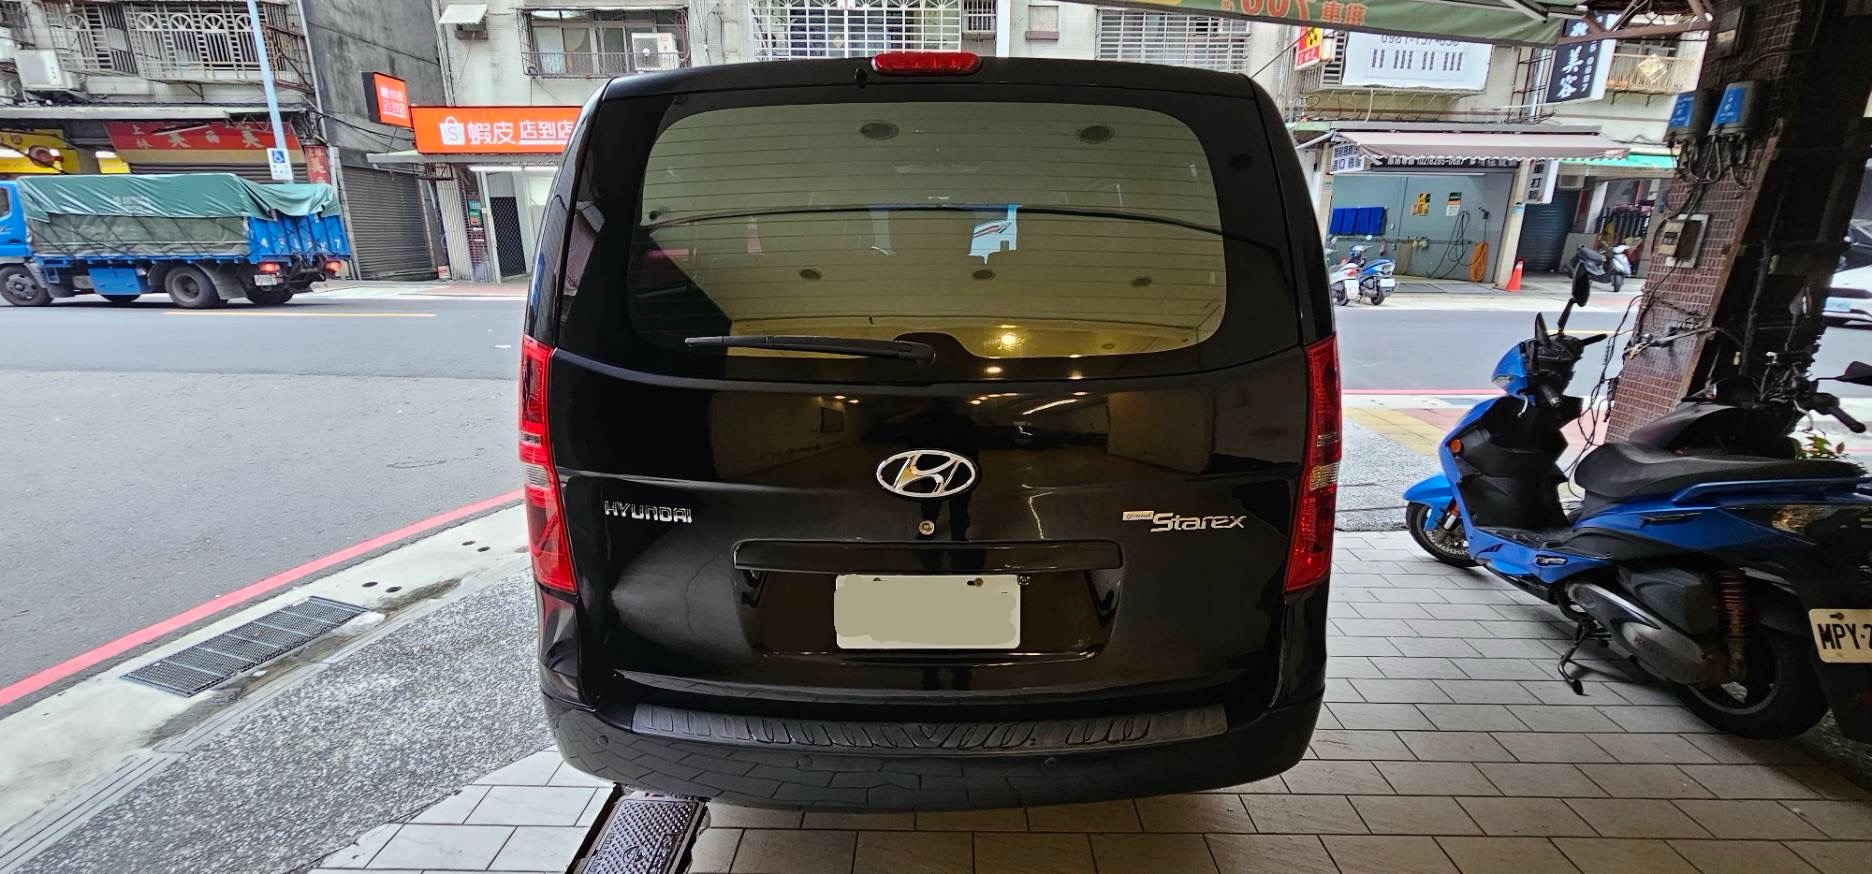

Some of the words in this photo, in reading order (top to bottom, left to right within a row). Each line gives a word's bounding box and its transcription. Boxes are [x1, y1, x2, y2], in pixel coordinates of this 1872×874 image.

[467, 121, 516, 145] 蝦皮
[519, 120, 574, 140] 店到店
[604, 500, 692, 524] HYUNDAI
[1150, 512, 1247, 533] Starex
